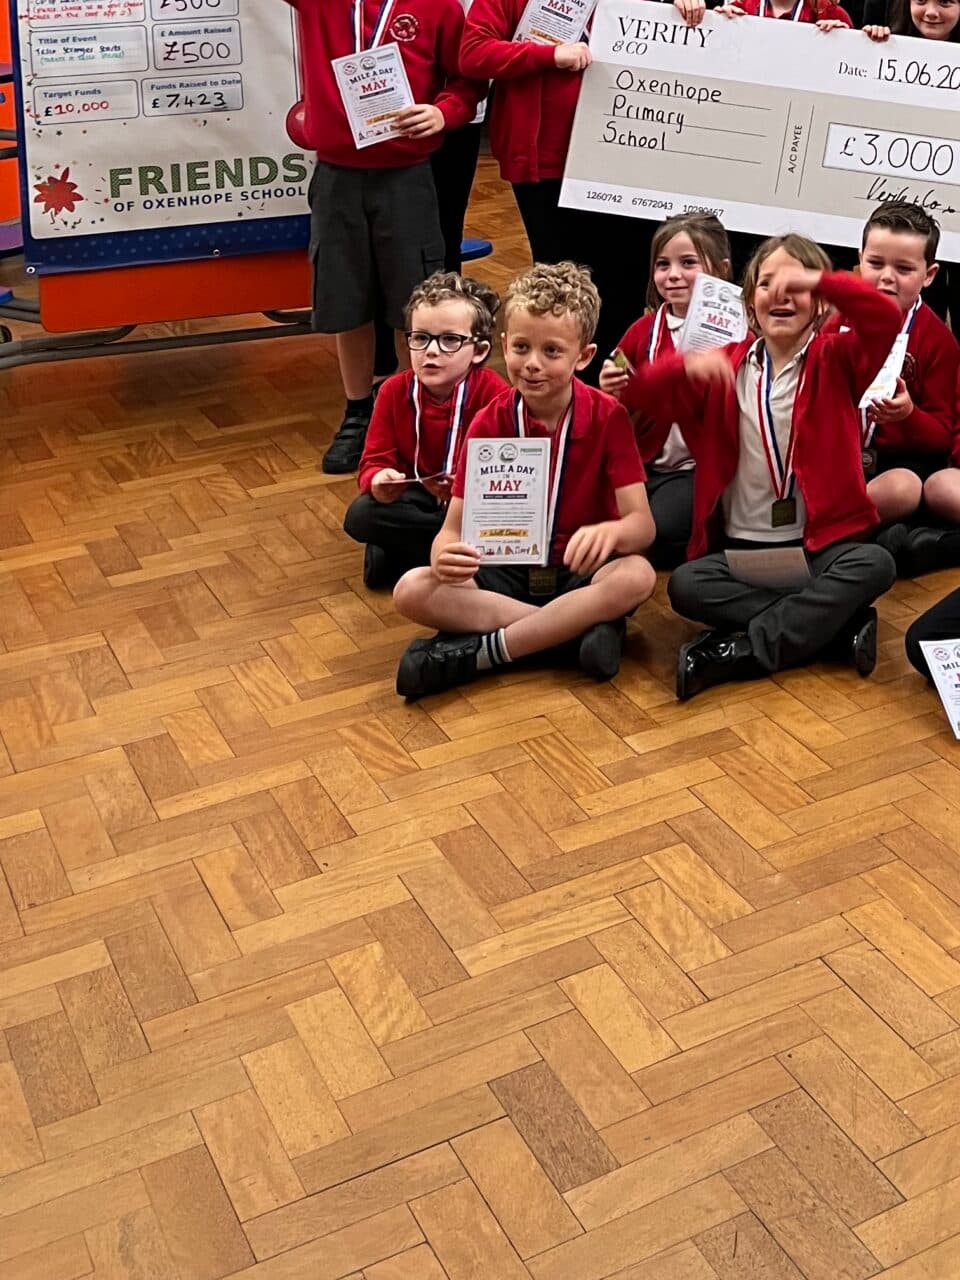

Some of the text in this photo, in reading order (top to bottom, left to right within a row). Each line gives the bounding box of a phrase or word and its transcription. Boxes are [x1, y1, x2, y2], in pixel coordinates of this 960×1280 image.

[548, 0, 573, 14] MAY
[618, 16, 714, 48] VERITY
[626, 41, 648, 55] CO
[838, 62, 868, 78] Date:
[42, 91, 71, 100] Target
[75, 89, 102, 97] Funds
[151, 83, 176, 91] Funds
[179, 81, 207, 89] Raised
[221, 78, 241, 86] Date
[361, 79, 387, 93] MAY
[616, 70, 722, 104] Oxenhope
[612, 94, 685, 134] Primary
[603, 120, 666, 150] School
[788, 125, 803, 174] A/C PAYEE
[109, 153, 308, 198] FRIENDS
[114, 187, 306, 213] OF OXENHOPE SCHOOL
[586, 191, 622, 203] 1260742
[632, 197, 673, 211] 67672043
[708, 313, 730, 329] MAY
[480, 464, 506, 475] MILE
[516, 465, 535, 475] DAY
[489, 480, 522, 491] MAY
